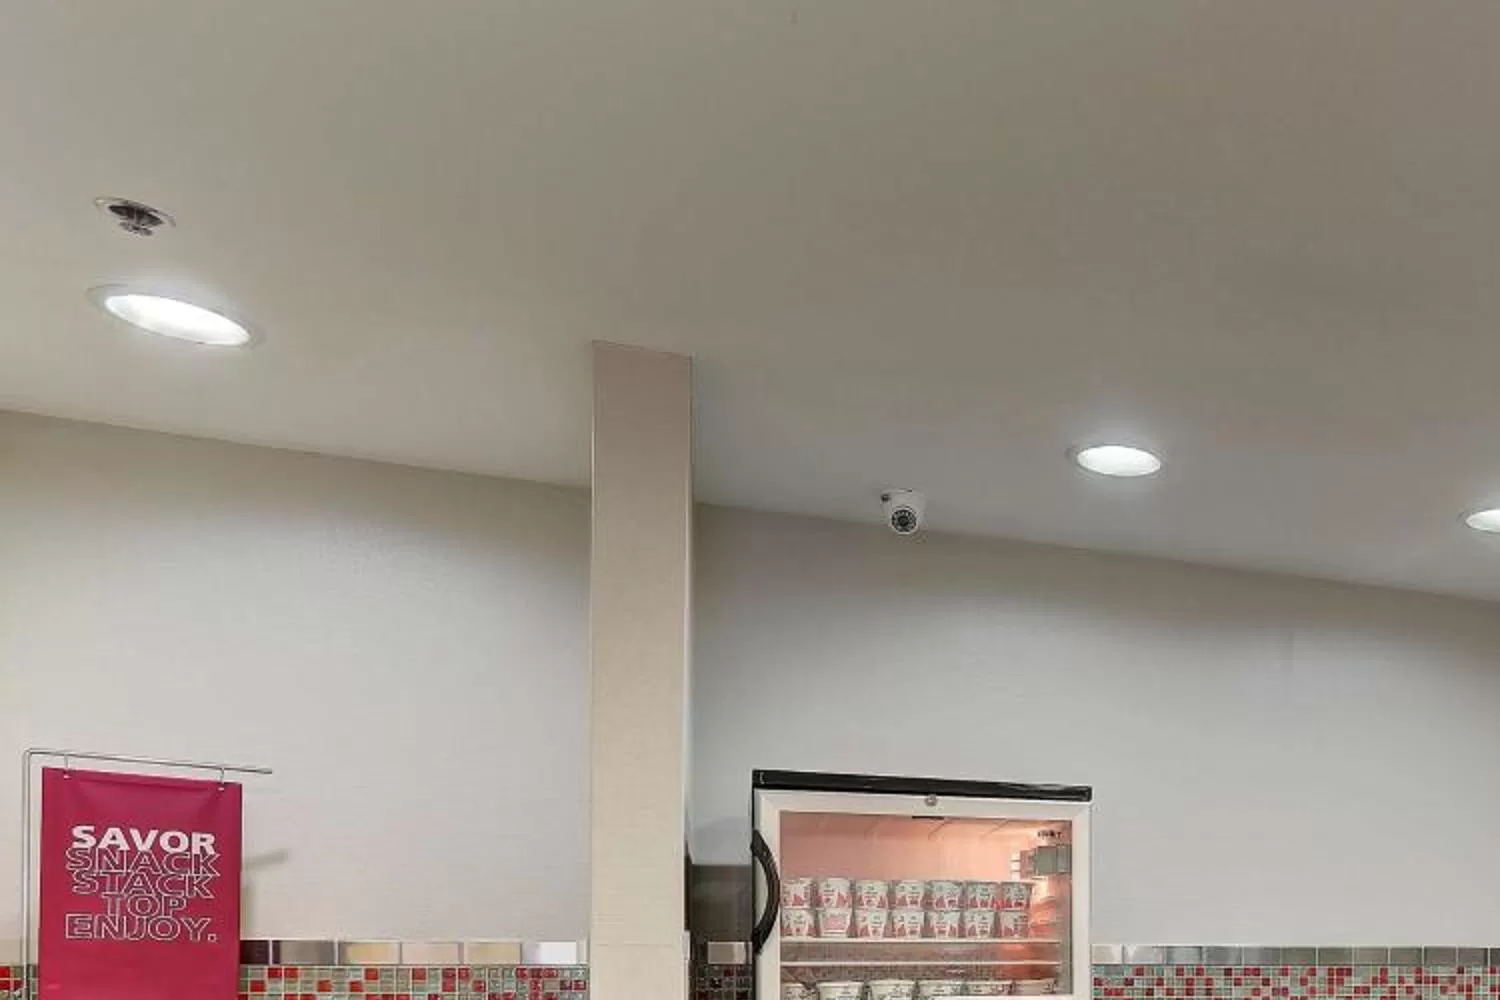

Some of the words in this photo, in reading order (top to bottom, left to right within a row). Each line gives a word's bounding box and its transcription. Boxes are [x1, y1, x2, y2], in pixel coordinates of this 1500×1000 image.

[71, 825, 216, 855] SAVOR
[65, 848, 221, 876] SNACK
[72, 870, 215, 899] STACK
[101, 894, 187, 918] TOP
[65, 913, 217, 943] ENJOY.
